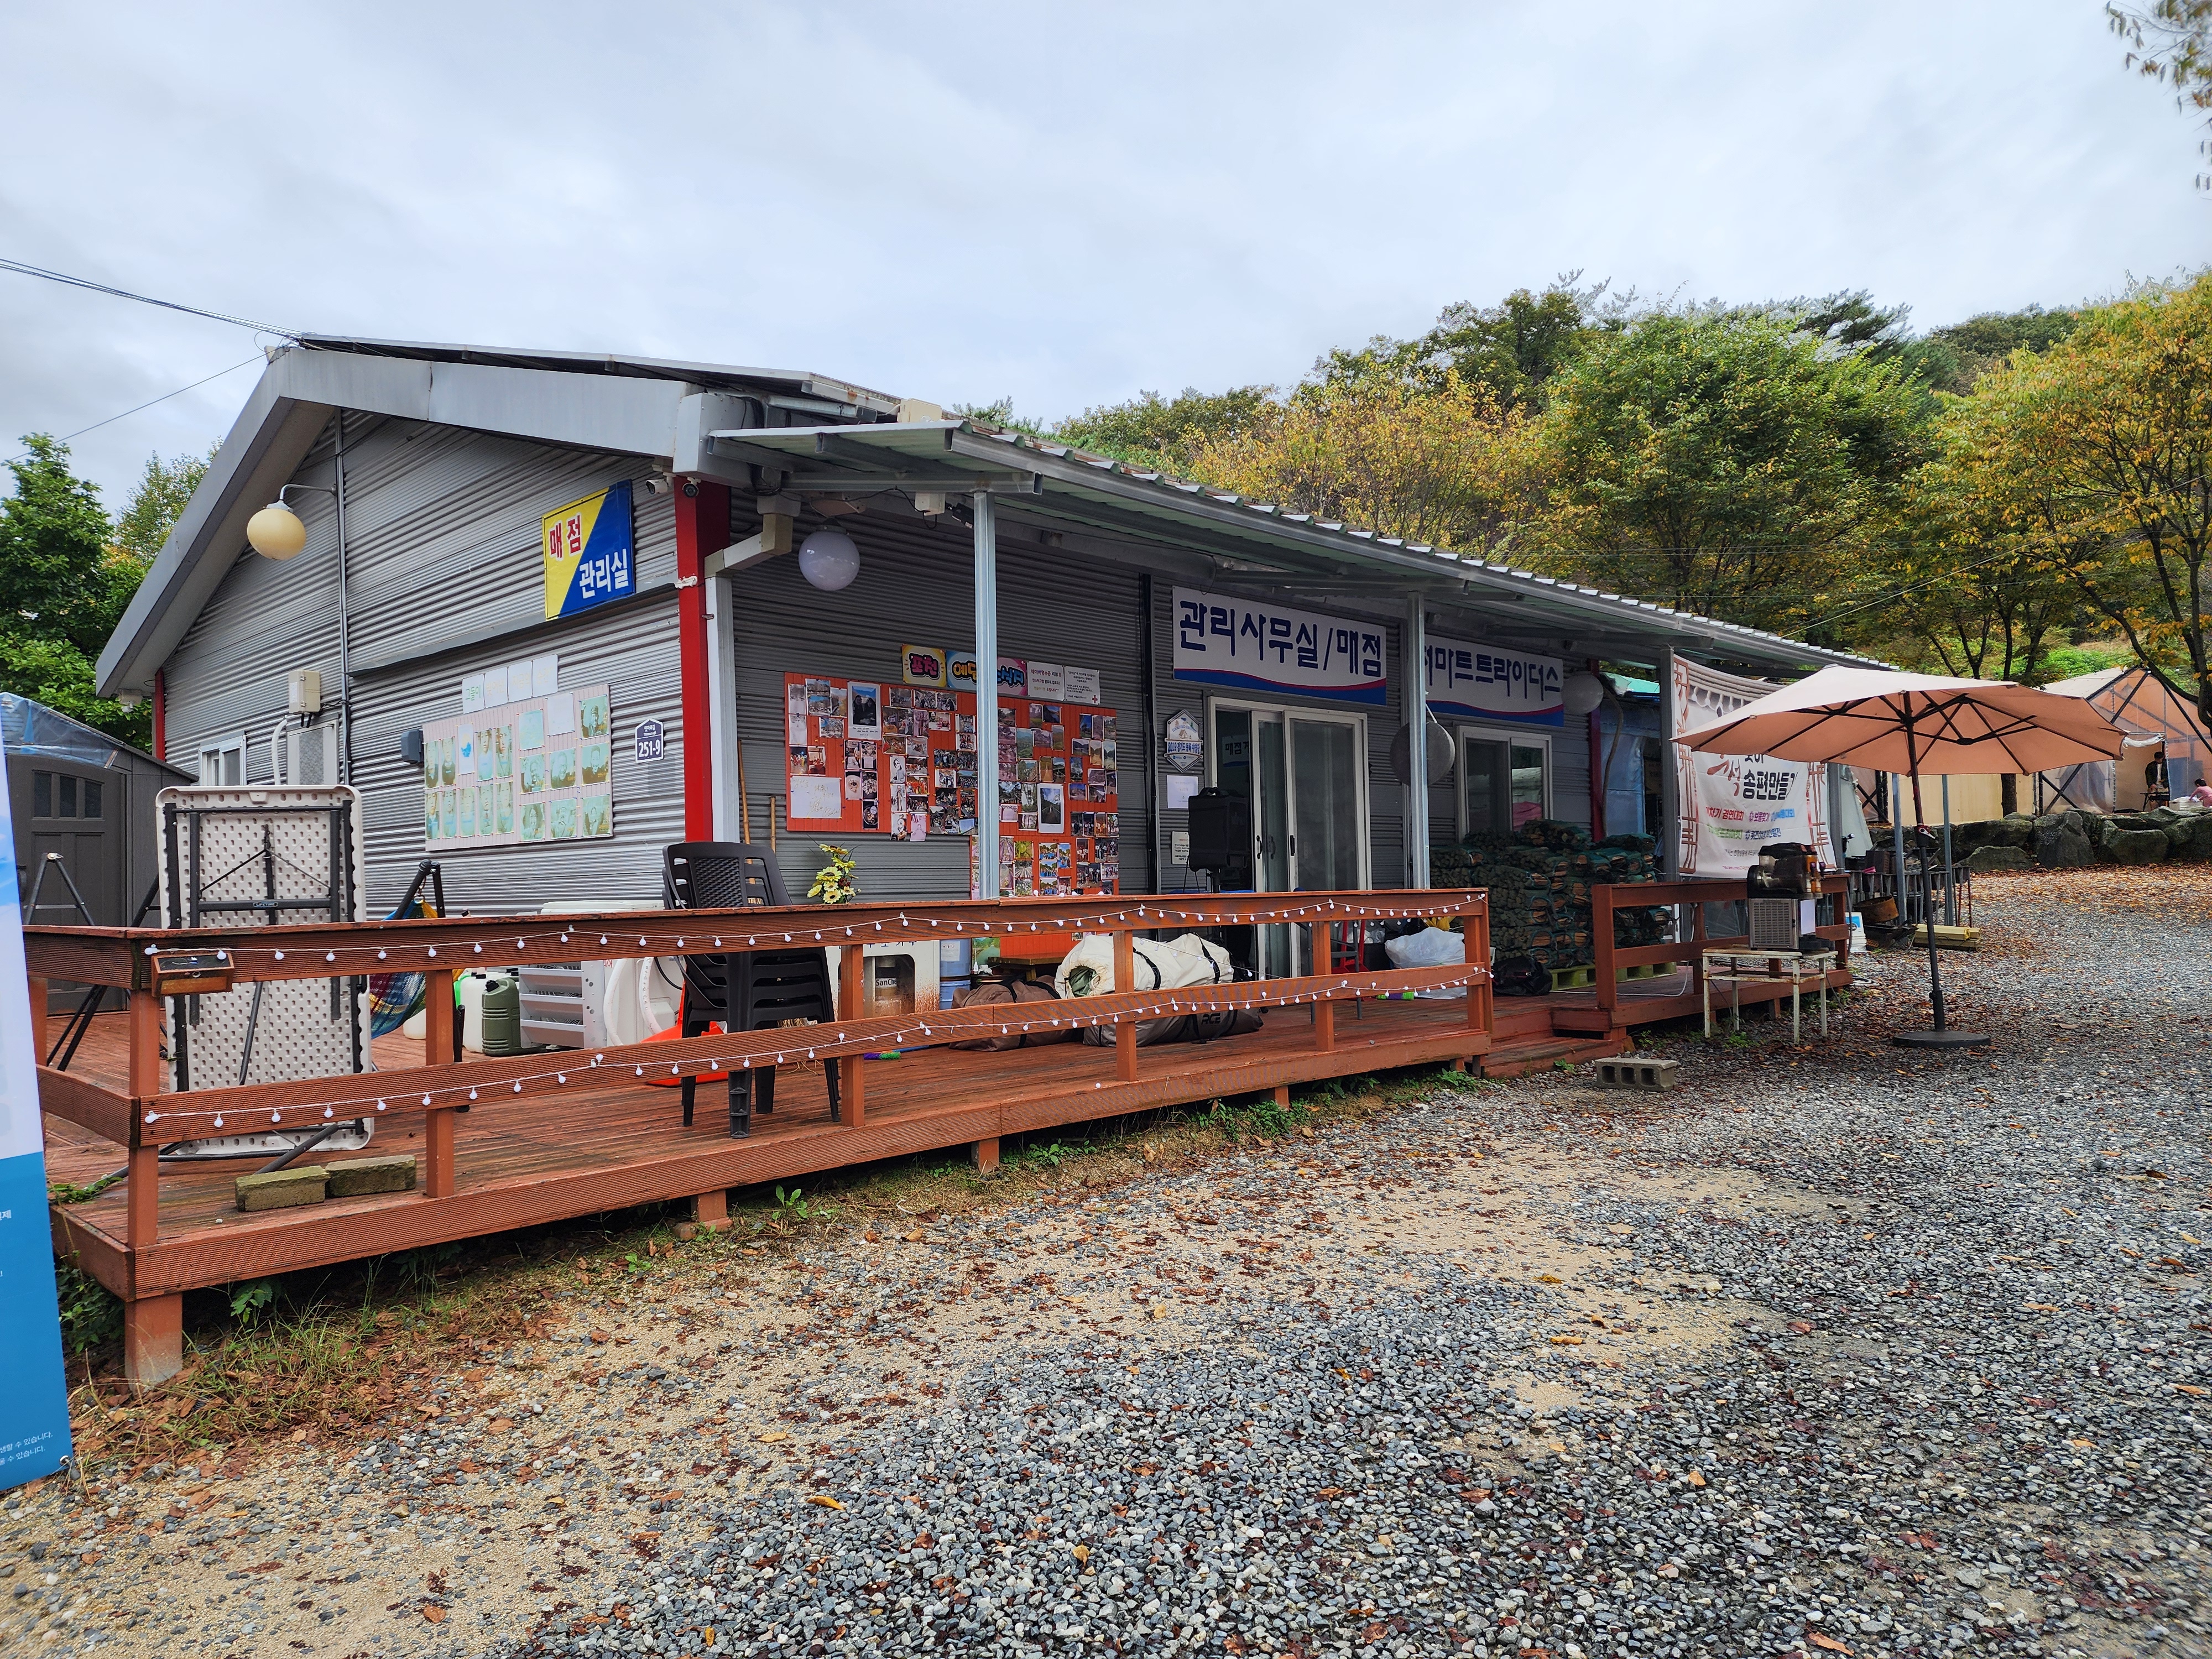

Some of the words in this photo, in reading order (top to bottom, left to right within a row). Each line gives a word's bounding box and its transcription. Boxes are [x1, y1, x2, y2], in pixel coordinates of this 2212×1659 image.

[579, 548, 629, 599] 관리실
[1180, 600, 1382, 678] 관리사무실/매점
[911, 654, 938, 676] 포천
[465, 684, 481, 701] 그들이
[638, 739, 660, 758] 251-9
[23, 1431, 54, 1446] 있습니다.
[15, 1445, 46, 1460] 있습니다.
